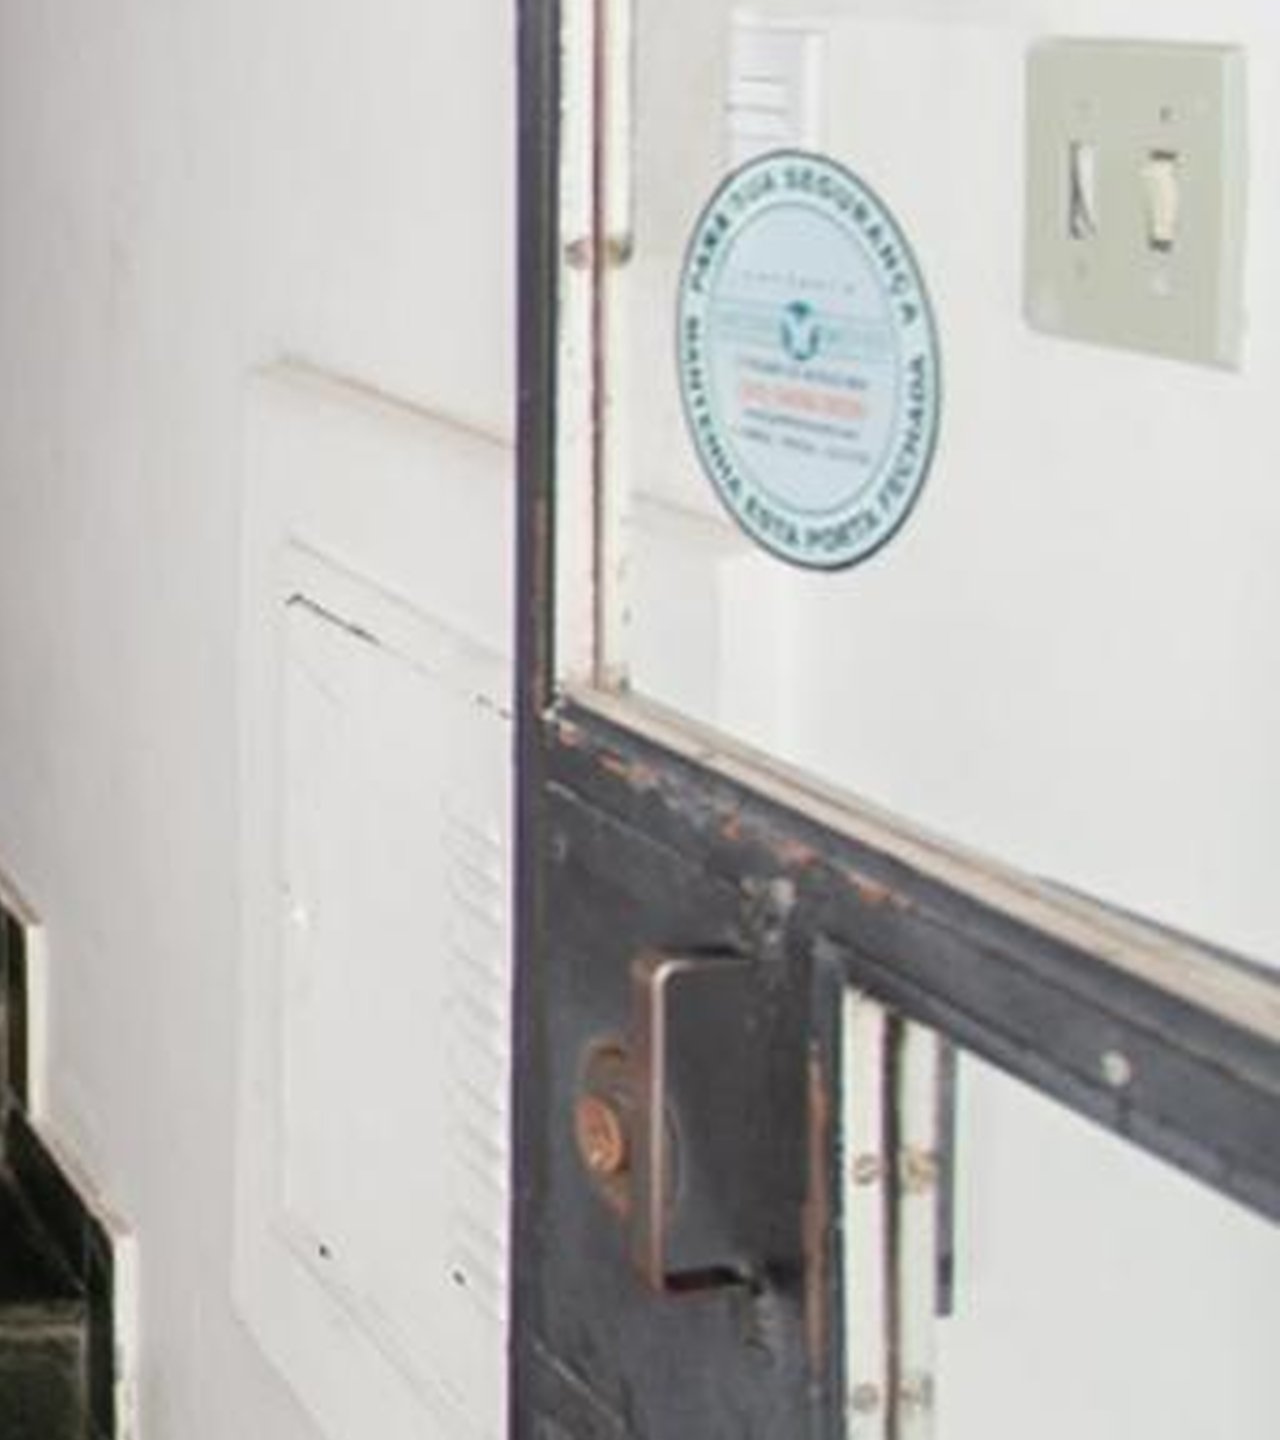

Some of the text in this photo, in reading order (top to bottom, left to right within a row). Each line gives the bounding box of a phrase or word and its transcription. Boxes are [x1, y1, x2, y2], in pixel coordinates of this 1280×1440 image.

[691, 211, 730, 292] PARA
[686, 316, 928, 554] MANTENHA ESTA PORTA FECHADA
